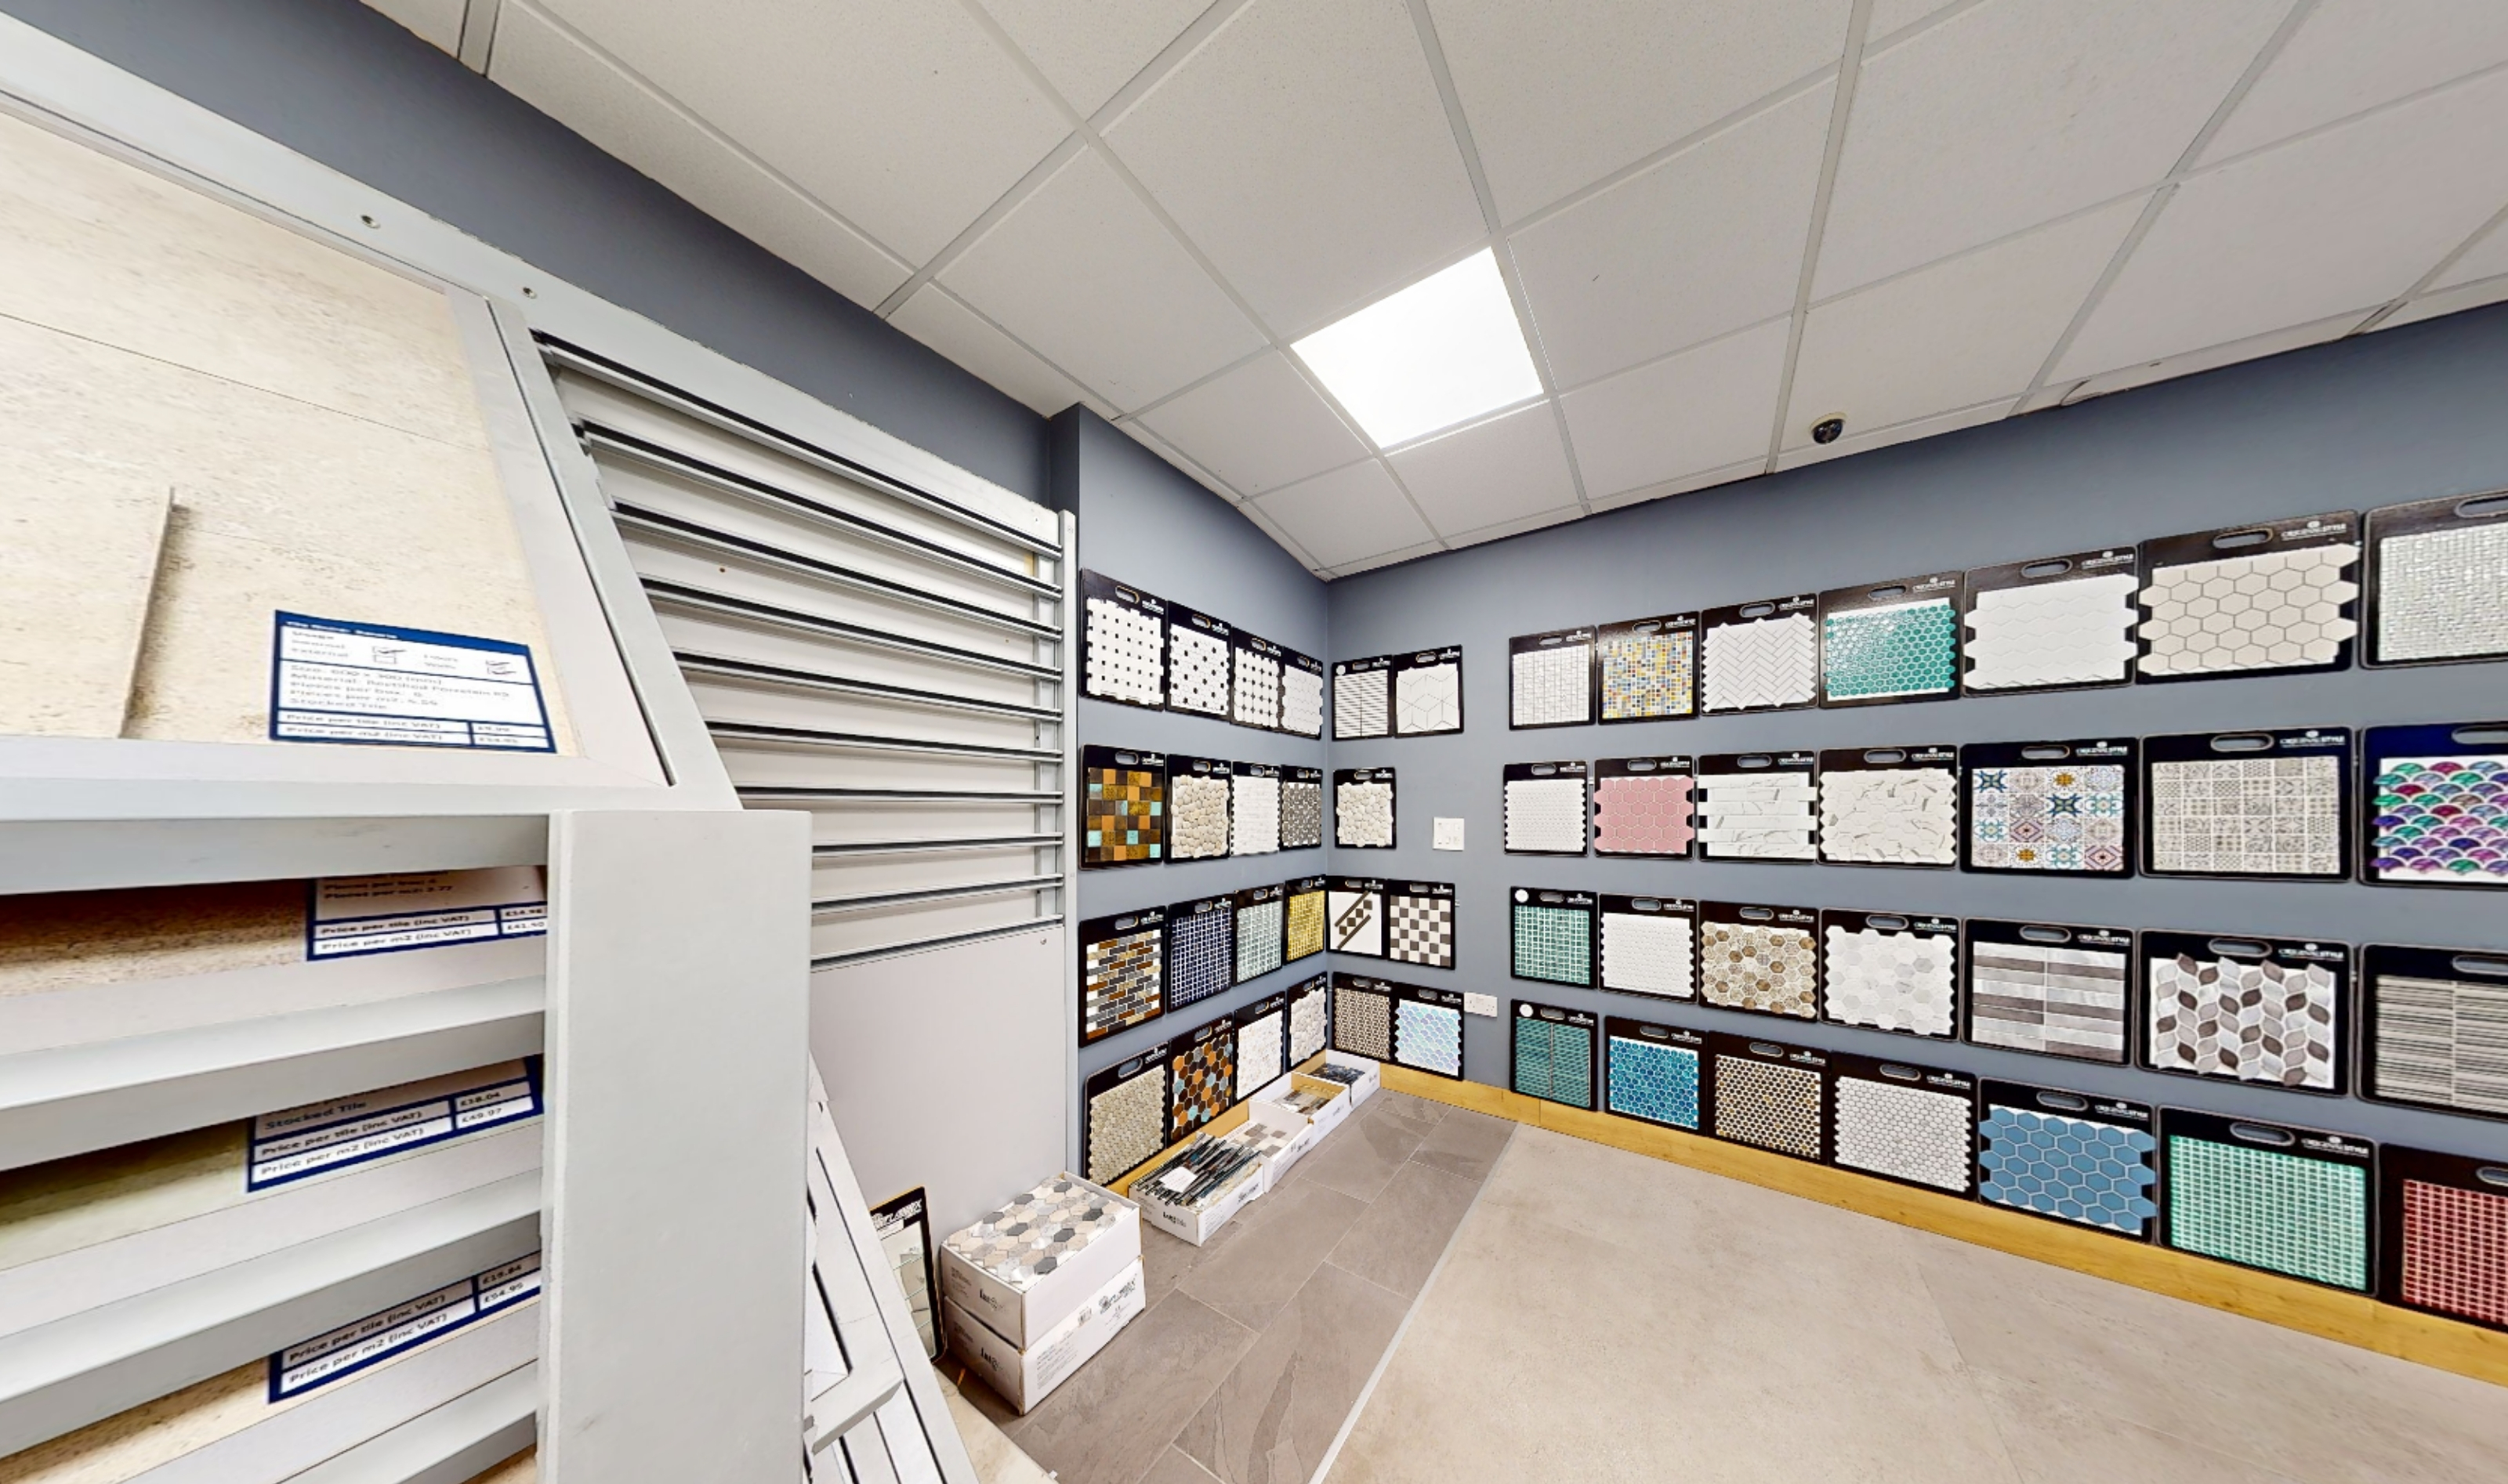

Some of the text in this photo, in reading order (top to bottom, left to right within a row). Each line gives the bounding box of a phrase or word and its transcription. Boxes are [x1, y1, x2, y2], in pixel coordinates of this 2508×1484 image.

[262, 1111, 421, 1156] Price per tile (inc VAT)
[265, 1102, 367, 1130] Stocked Tile
[262, 1128, 423, 1174] Price per m2 (inc VAT)
[289, 1294, 445, 1361] Price per tile (inc VAT)
[290, 1314, 447, 1381] Price per m2 (inc VAT)
